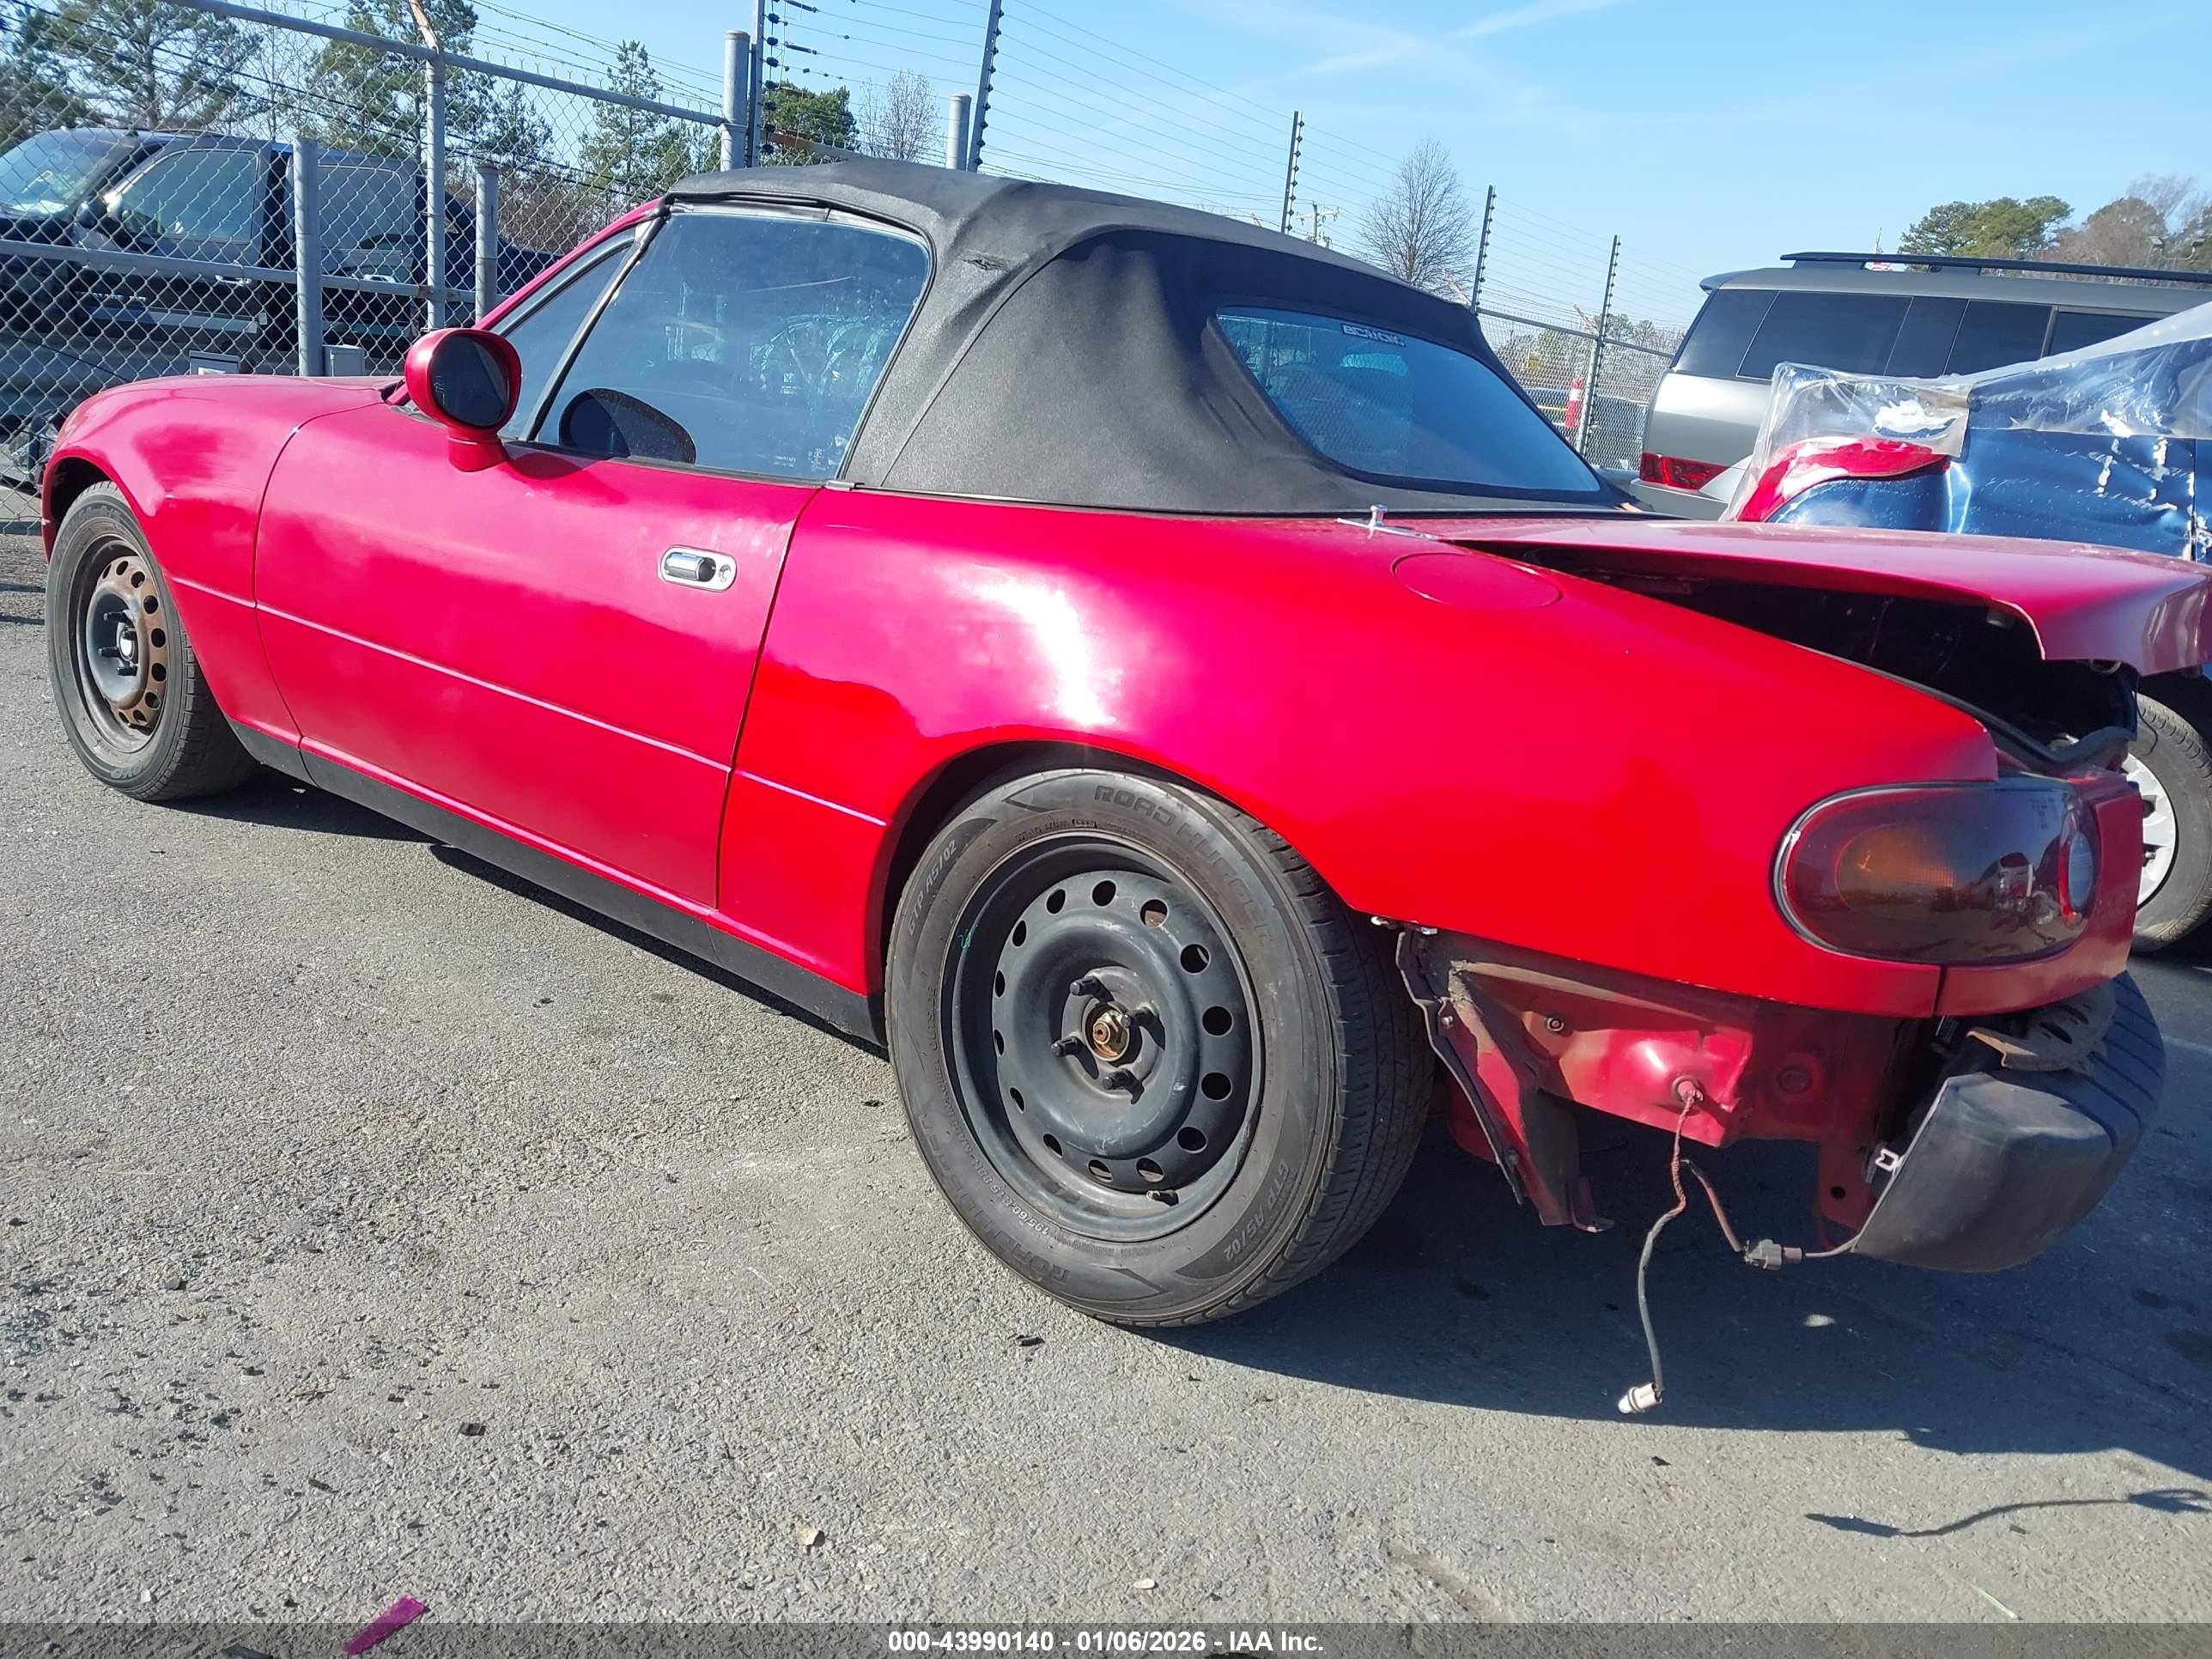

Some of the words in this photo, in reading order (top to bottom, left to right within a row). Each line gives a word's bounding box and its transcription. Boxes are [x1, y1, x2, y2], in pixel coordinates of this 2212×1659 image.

[1094, 785, 1177, 826] ROAD
[908, 890, 925, 936] GTP
[926, 839, 957, 894] AS/02
[1267, 1158, 1290, 1210] GTP
